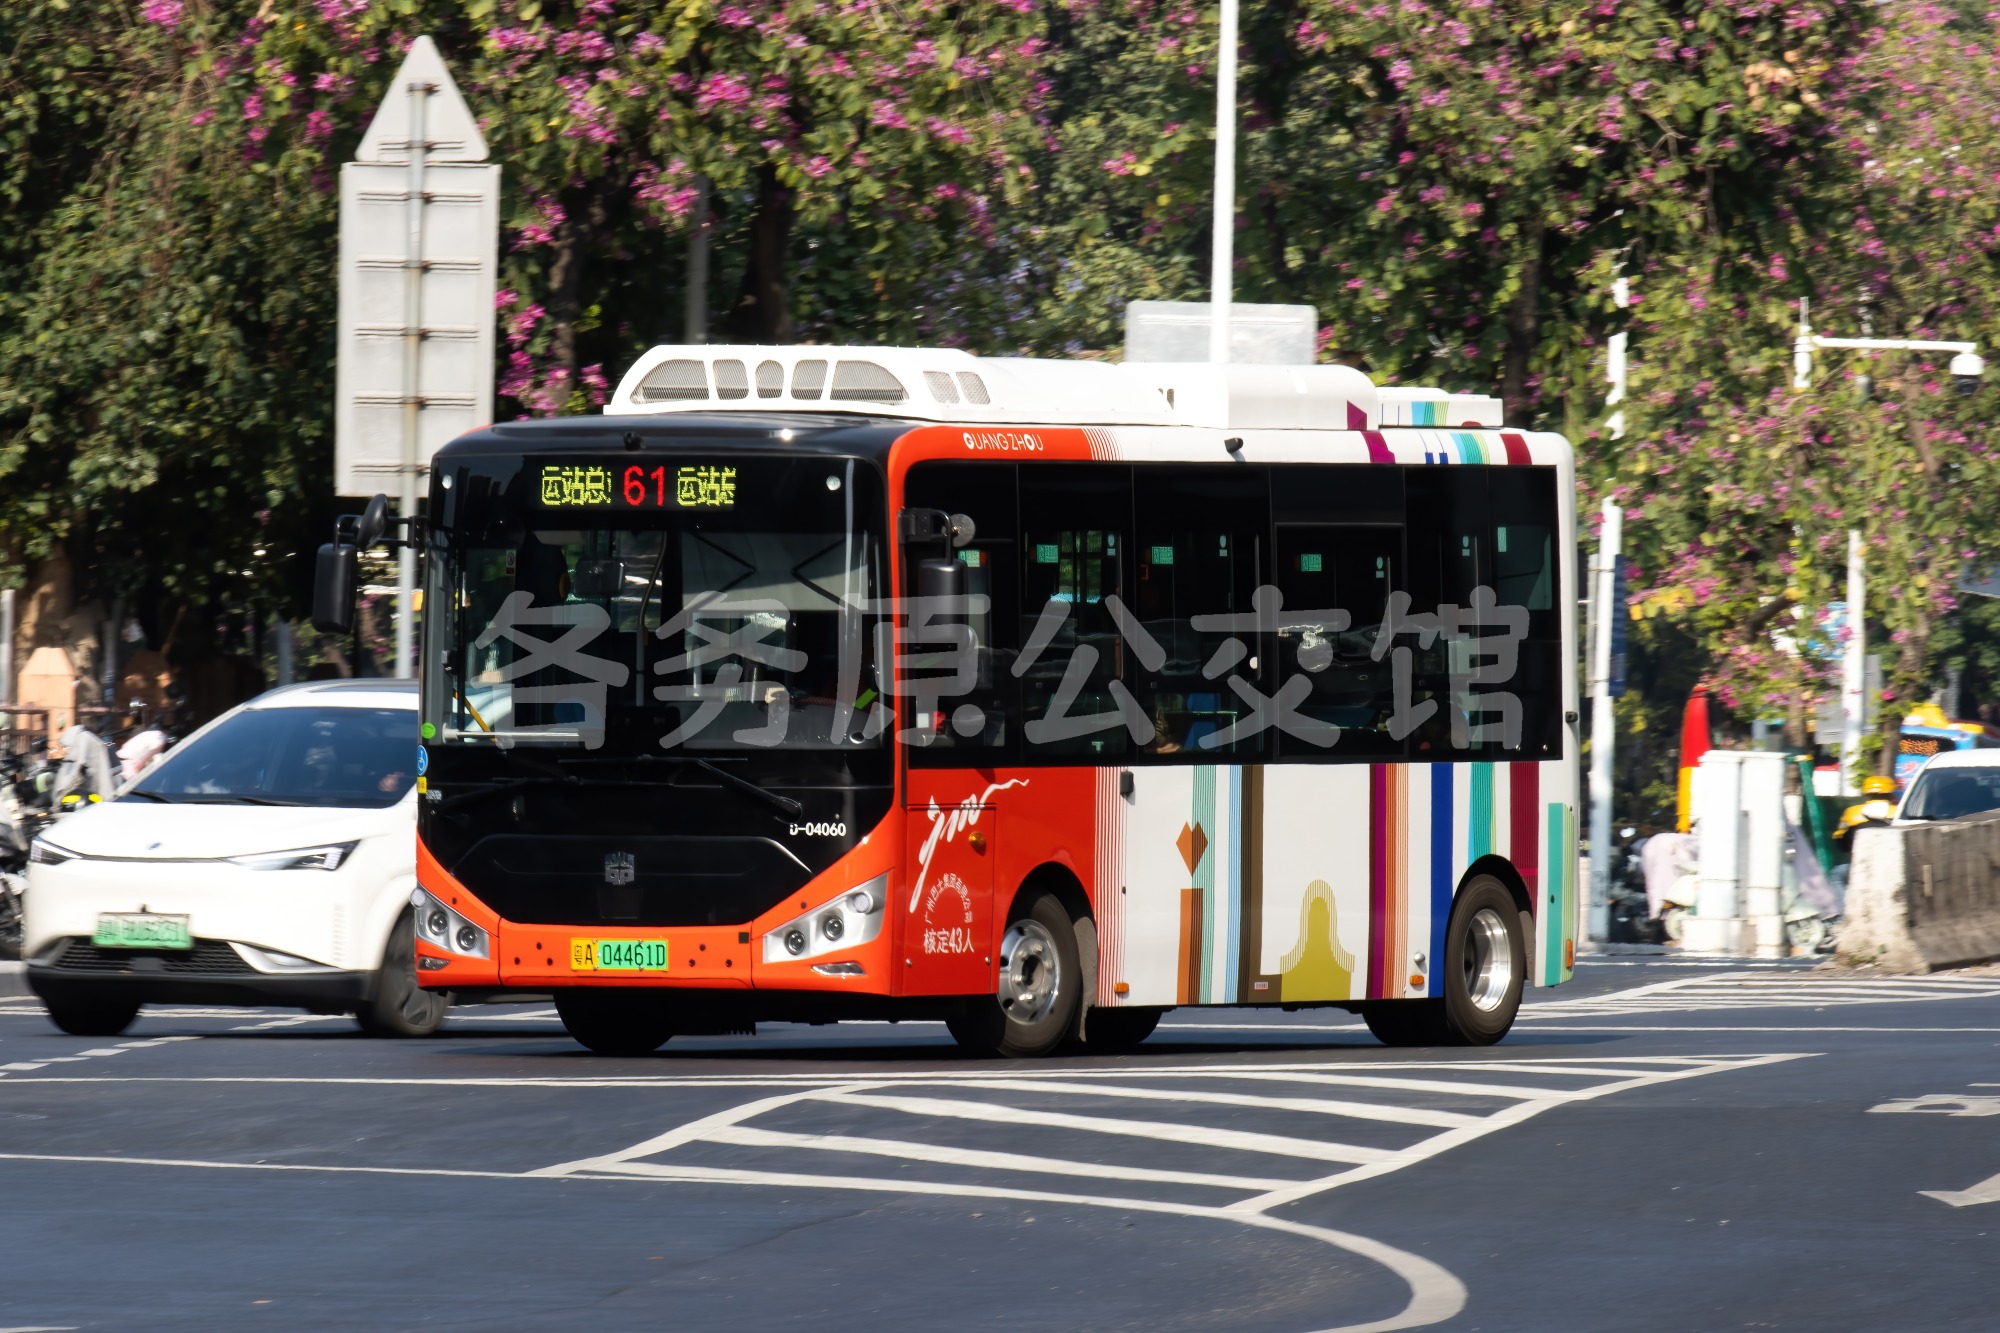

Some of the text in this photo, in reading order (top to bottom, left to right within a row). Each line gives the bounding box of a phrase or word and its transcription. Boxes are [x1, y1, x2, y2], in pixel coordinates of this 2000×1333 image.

[963, 432, 1044, 451] GUANGZHOU
[623, 465, 665, 506] 61
[789, 822, 847, 837] D-04060
[923, 926, 975, 955] 核定43人
